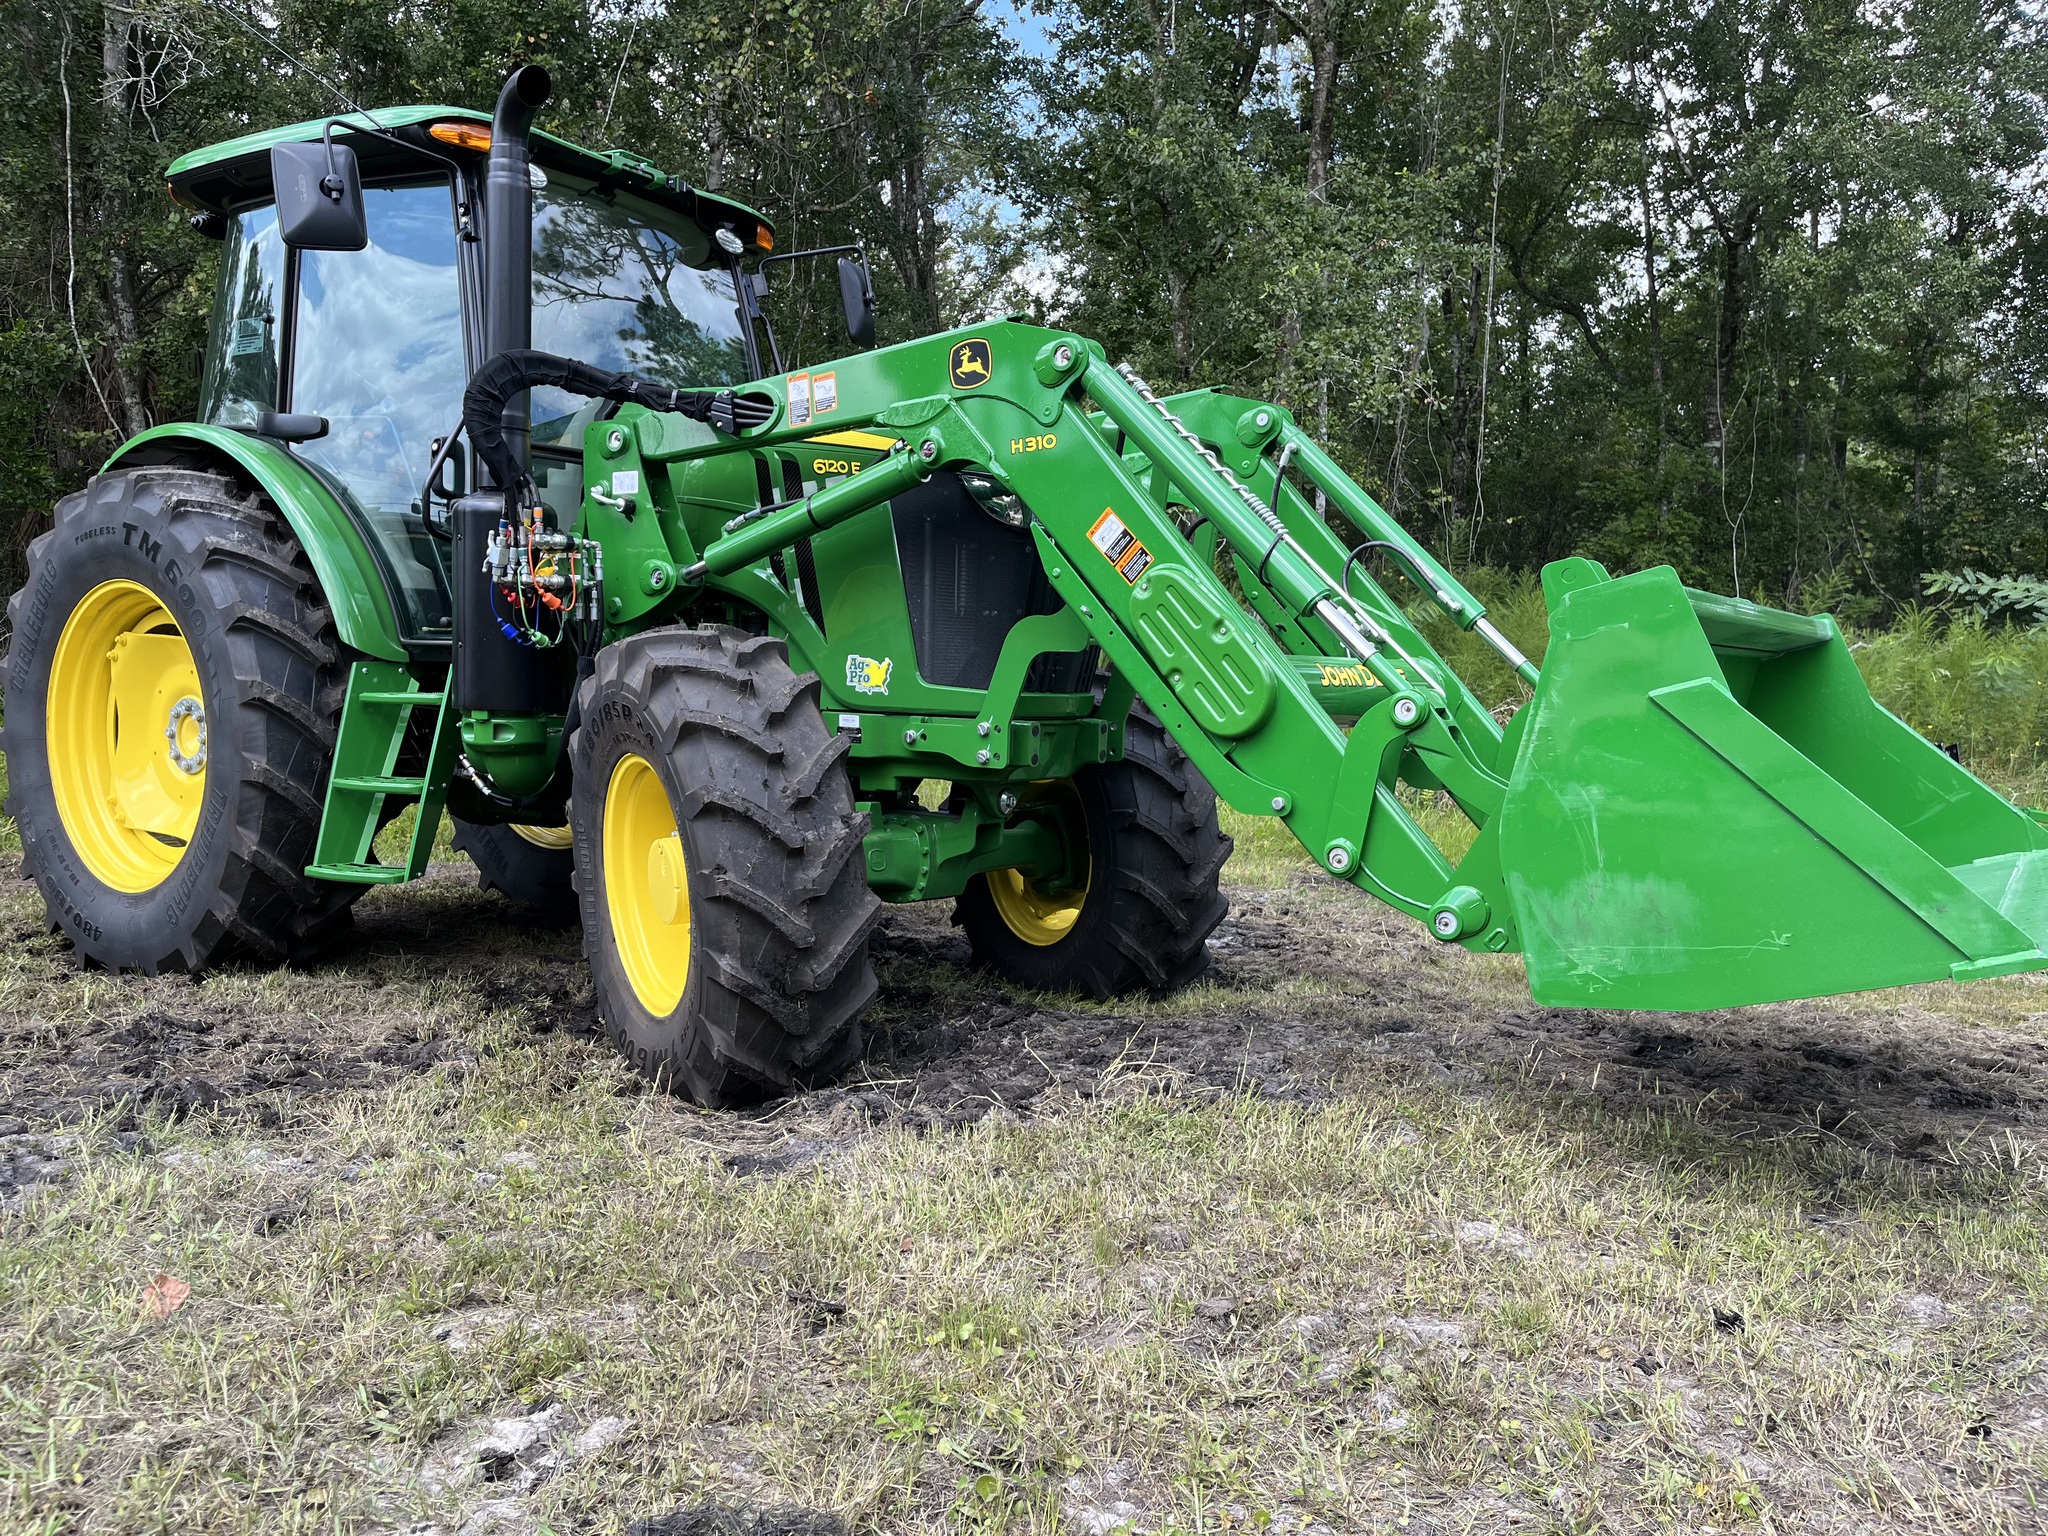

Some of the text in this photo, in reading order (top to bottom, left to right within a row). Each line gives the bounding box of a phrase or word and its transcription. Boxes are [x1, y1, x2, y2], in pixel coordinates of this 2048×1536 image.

[74, 526, 117, 546] TUBELESS
[10, 558, 57, 694] TRELLEBORG
[849, 671, 870, 683] Pro
[1315, 662, 1363, 687] JOHN
[165, 787, 228, 928] TRELLEBORG
